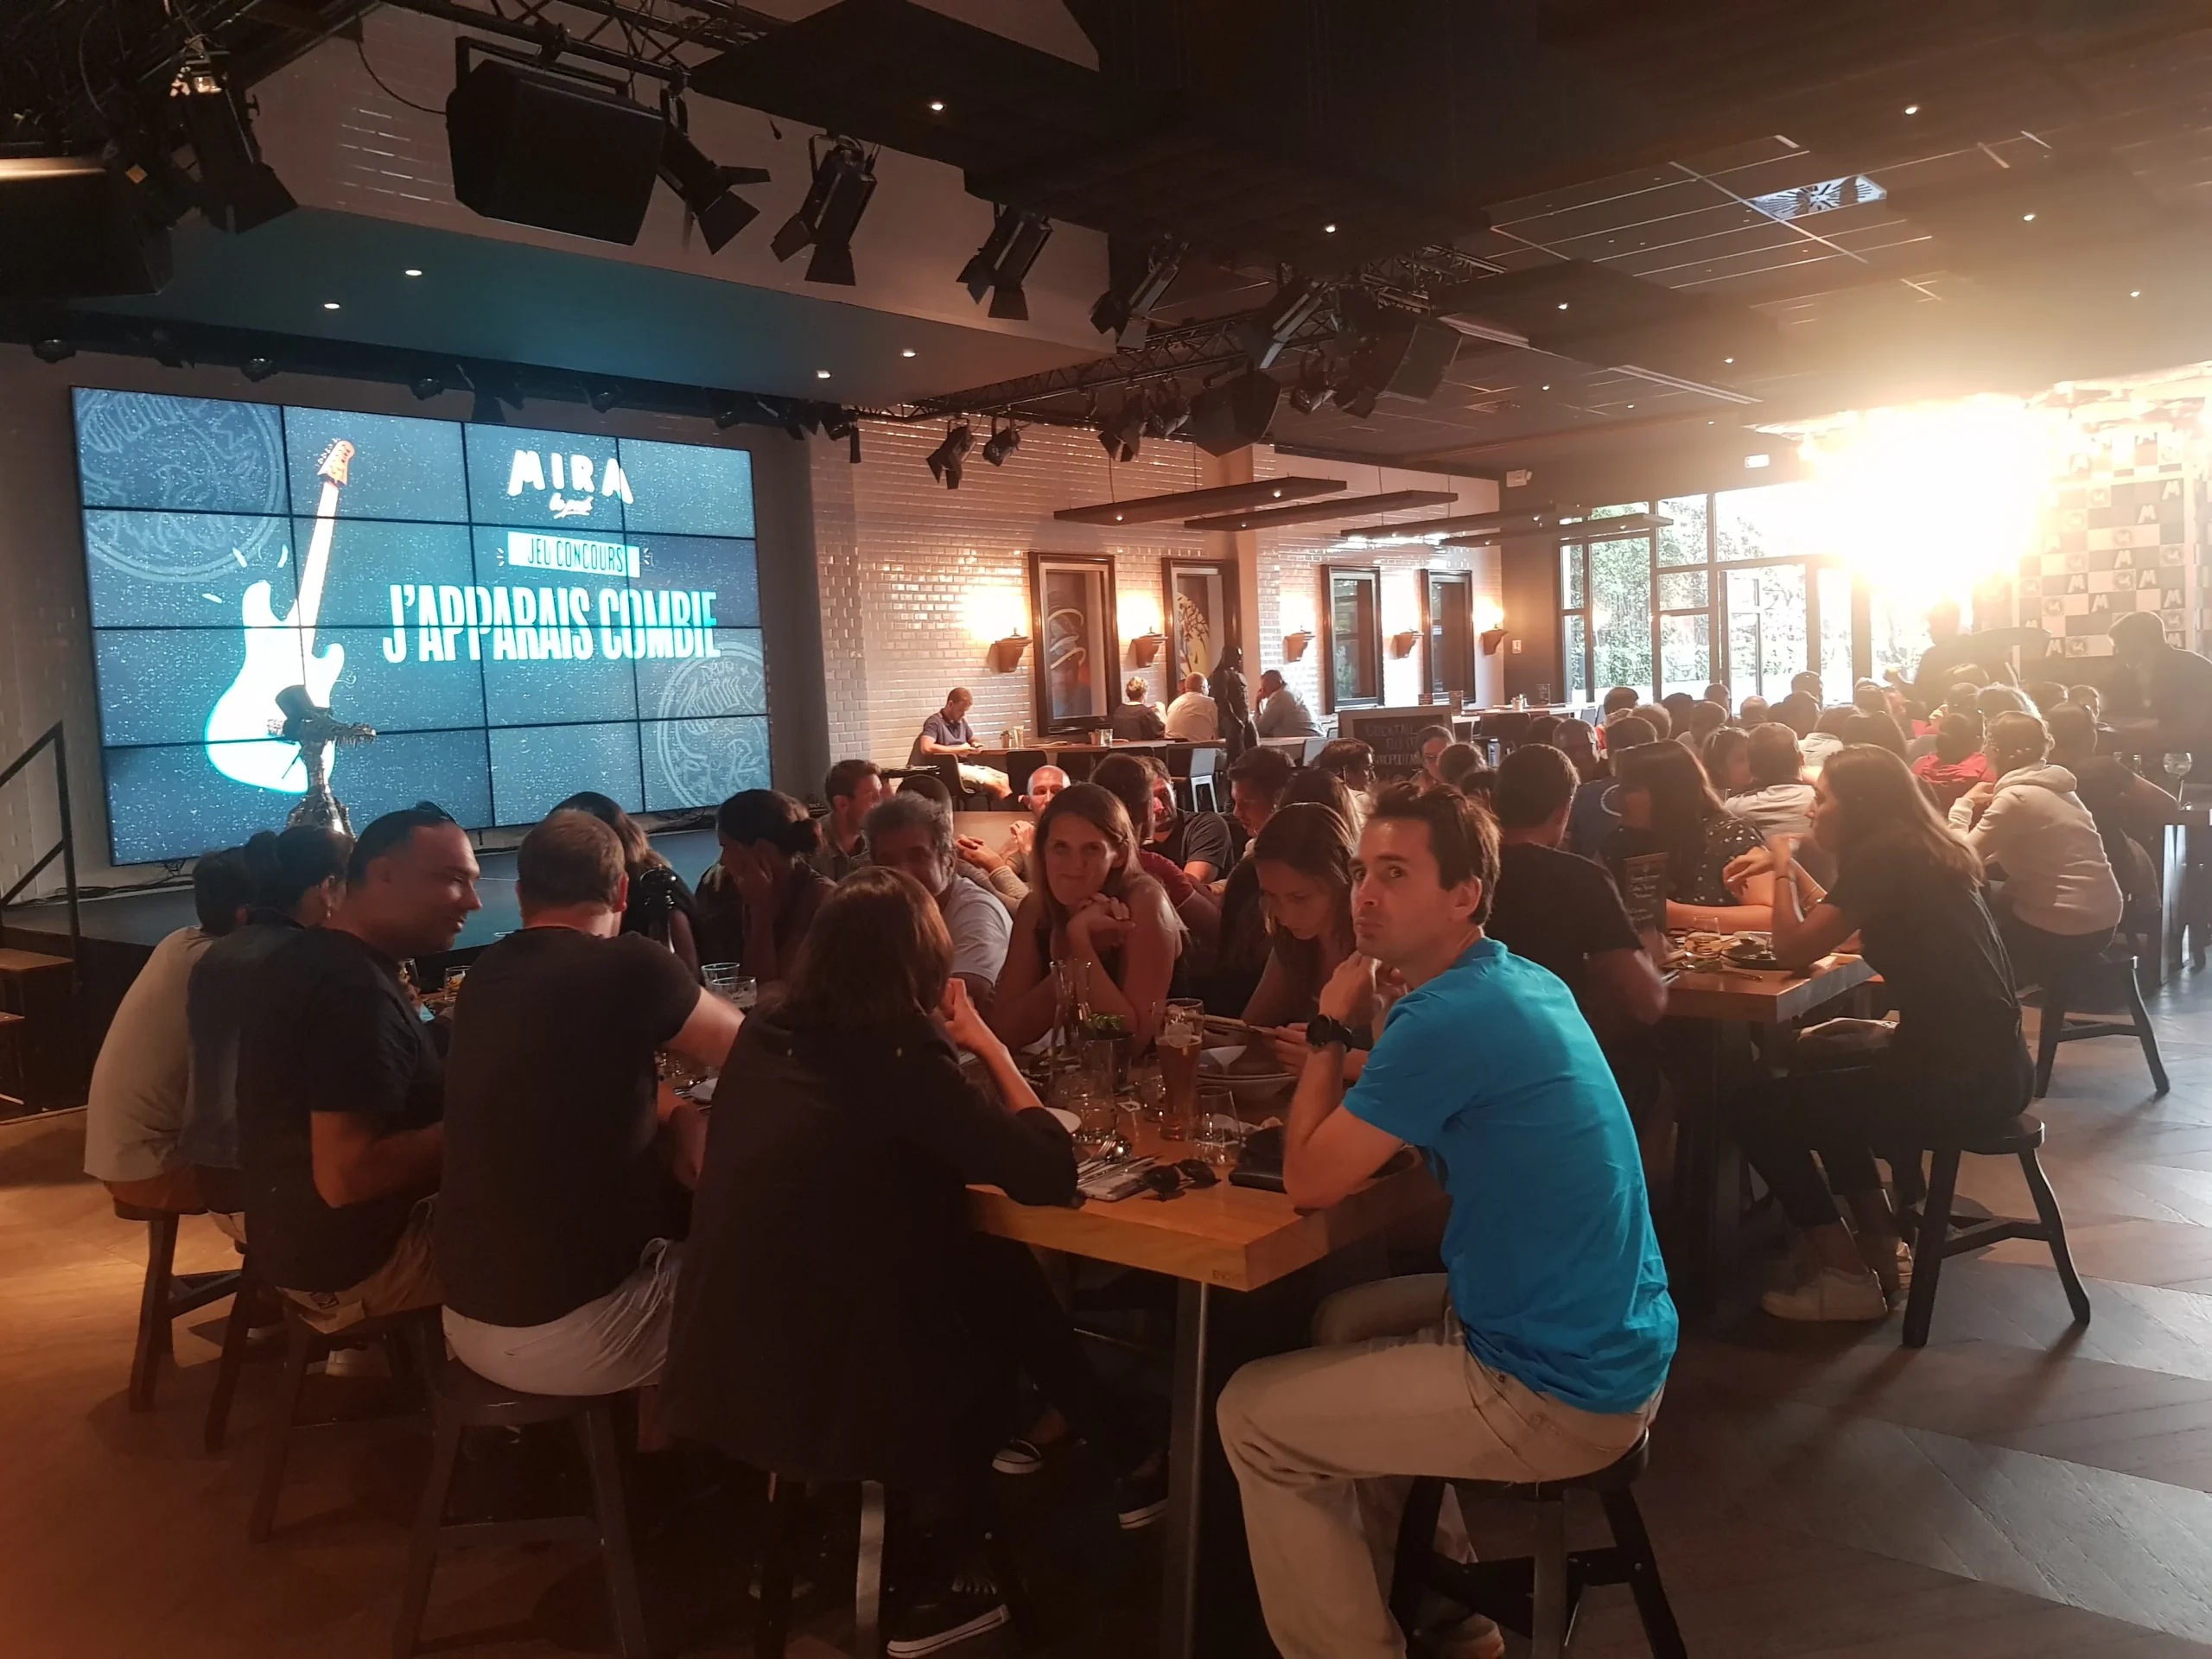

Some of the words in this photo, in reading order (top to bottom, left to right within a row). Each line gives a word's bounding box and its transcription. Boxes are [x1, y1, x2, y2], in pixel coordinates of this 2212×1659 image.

[506, 449, 634, 505] MIRA
[556, 540, 625, 573] CONCOURS
[382, 583, 594, 664] J'APPARAIS
